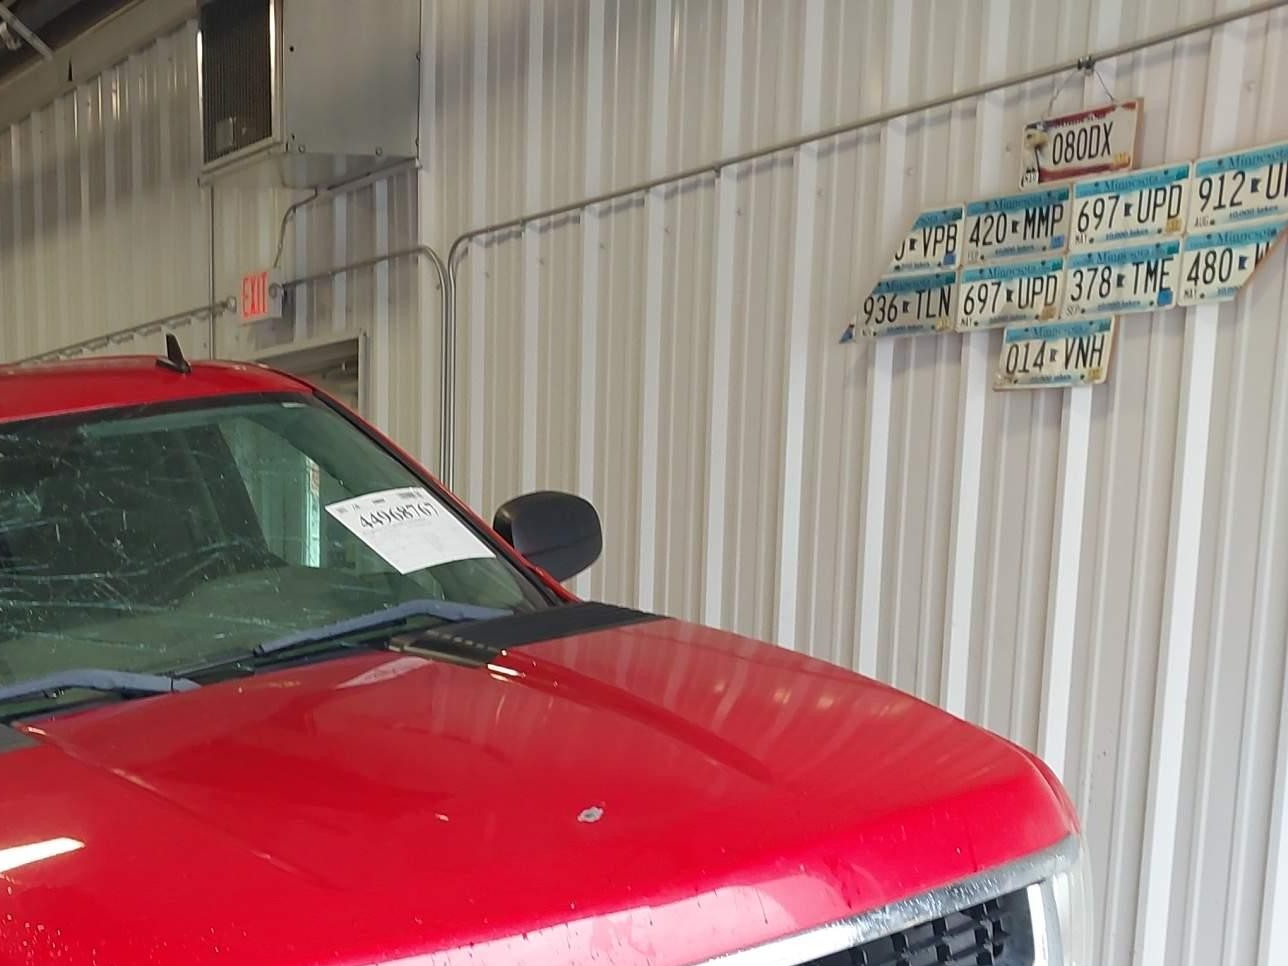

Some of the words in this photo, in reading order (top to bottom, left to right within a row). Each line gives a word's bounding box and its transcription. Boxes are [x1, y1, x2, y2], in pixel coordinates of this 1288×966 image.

[1052, 121, 1114, 165] 080DX
[1077, 194, 1120, 233] 697
[1137, 184, 1183, 223] UPD
[1198, 170, 1247, 213] 912
[922, 223, 958, 258] VPB
[968, 211, 1007, 248] 420
[1023, 203, 1064, 241] MMP
[1070, 265, 1112, 302] 378
[1132, 257, 1175, 296] TME
[1187, 247, 1234, 287] 480
[242, 271, 269, 321] EXIT
[863, 293, 899, 325] 936
[915, 285, 952, 321] TLN
[963, 281, 1002, 316] 697
[1017, 274, 1058, 310] UPD
[1006, 340, 1047, 375] 014
[1063, 333, 1105, 370] VNH
[359, 502, 440, 529] 44968767
